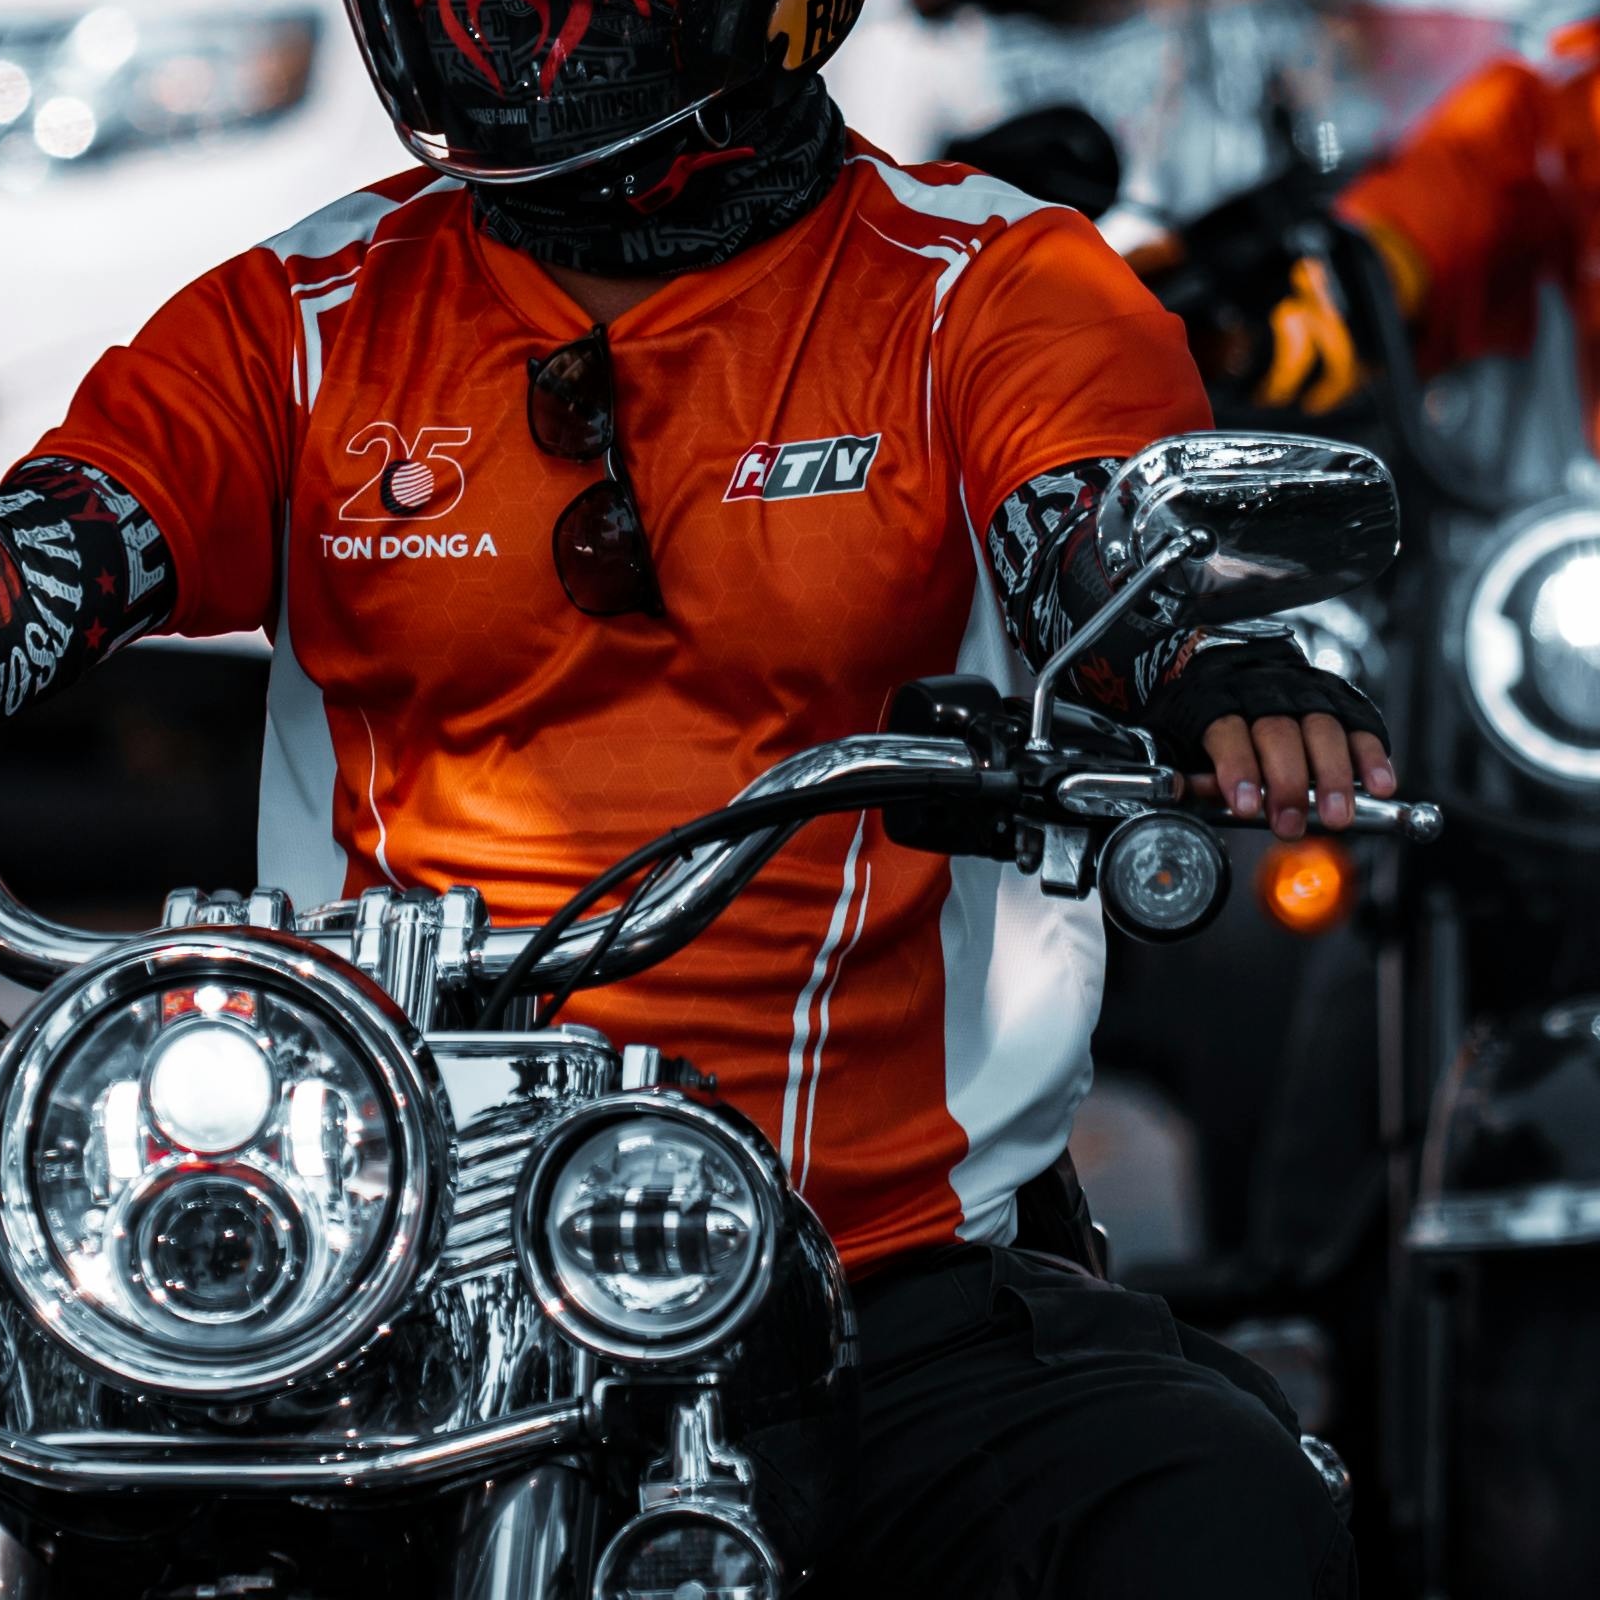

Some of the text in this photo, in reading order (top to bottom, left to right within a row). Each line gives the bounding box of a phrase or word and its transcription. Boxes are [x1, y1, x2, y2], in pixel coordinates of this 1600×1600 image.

[338, 421, 472, 522] 25
[733, 444, 872, 492] HTV
[320, 532, 498, 560] TON DONG A
